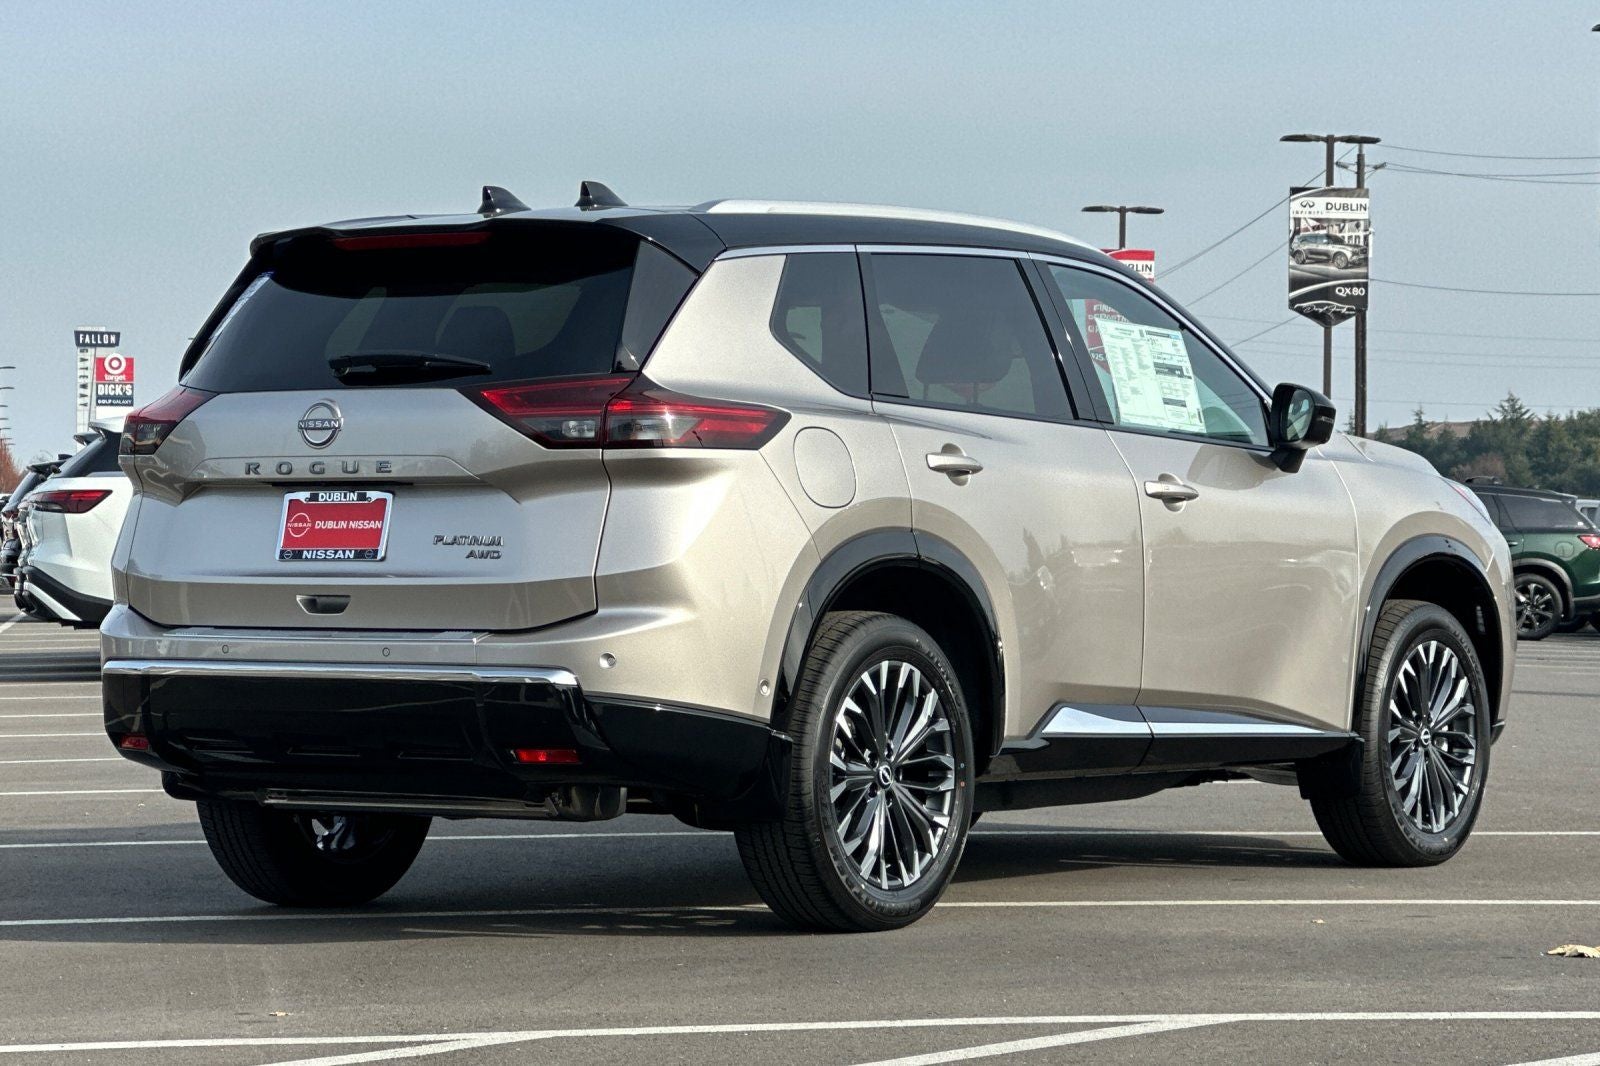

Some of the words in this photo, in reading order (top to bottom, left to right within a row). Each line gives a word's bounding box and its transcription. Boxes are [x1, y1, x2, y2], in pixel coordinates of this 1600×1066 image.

[1325, 202, 1367, 212] DUBLIN
[79, 333, 116, 344] FALLON
[78, 348, 89, 407] GATEWAY
[97, 384, 132, 396] DICK'S
[298, 419, 340, 429] NISSAN
[244, 460, 393, 475] ROGUE
[318, 492, 358, 502] DUBLIN
[314, 519, 347, 529] DUBLIN
[348, 519, 382, 529] NISSAN
[433, 534, 505, 547] PLATINUM
[302, 549, 355, 560] NISSAN
[464, 549, 502, 560] AWD
